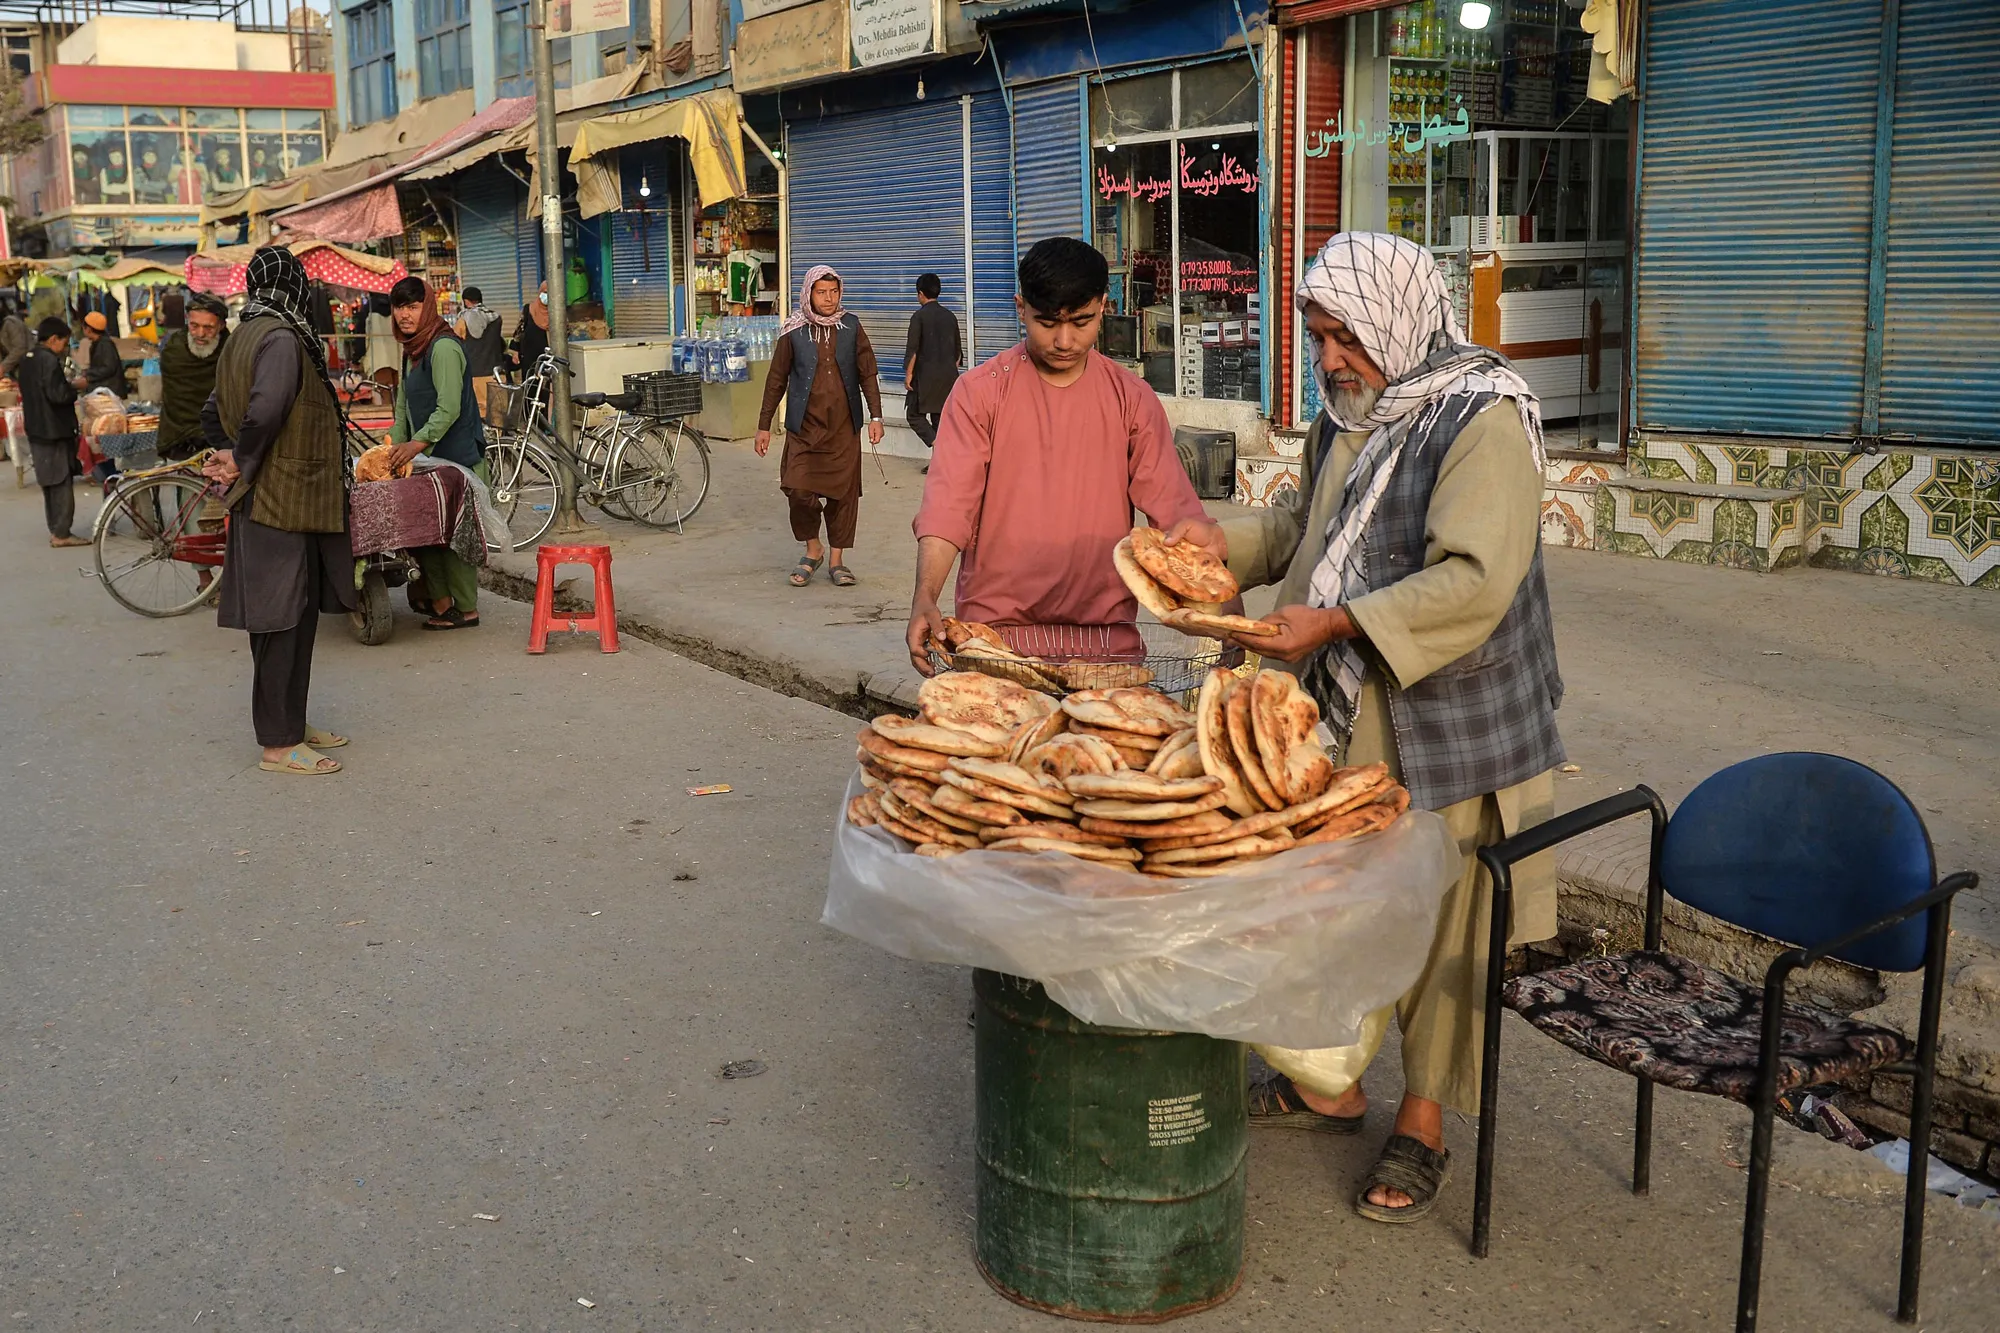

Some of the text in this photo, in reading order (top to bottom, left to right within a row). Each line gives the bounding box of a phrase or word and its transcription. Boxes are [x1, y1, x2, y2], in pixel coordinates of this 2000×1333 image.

[858, 19, 927, 46] Drs. Mehdia Behishti
[876, 49, 882, 58] &
[894, 41, 920, 56] Specialist
[1404, 94, 1469, 154] فیصل
[1180, 260, 1232, 276] 0793580008
[1181, 277, 1229, 292] 0773007916
[1148, 1098, 1177, 1107] CALCIUM
[1148, 1115, 1163, 1123] GAS
[1148, 1123, 1162, 1131] NET
[1148, 1131, 1171, 1139] GROSS
[1149, 1139, 1169, 1147] MADE
[1177, 1135, 1196, 1145] CHINA
